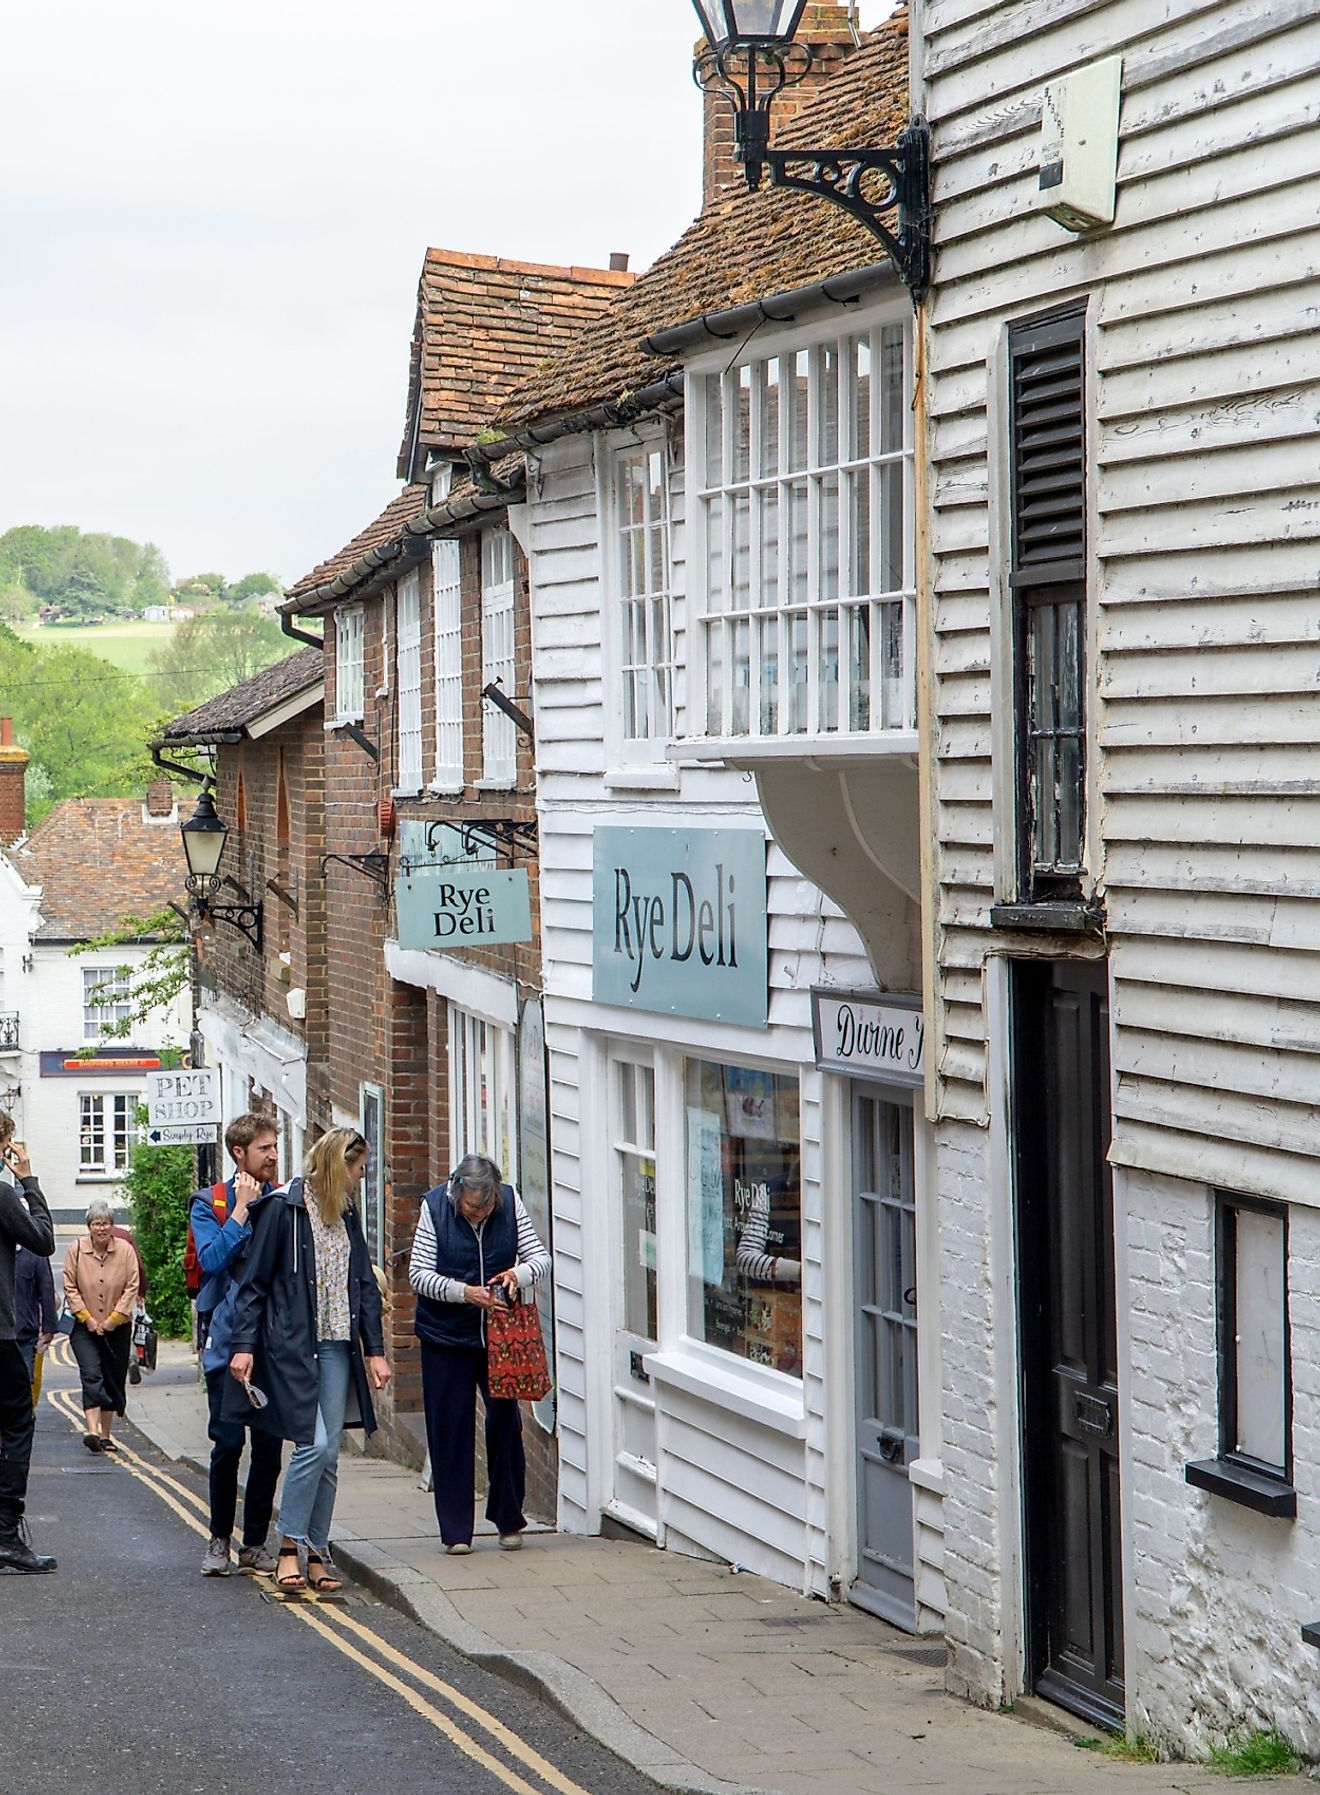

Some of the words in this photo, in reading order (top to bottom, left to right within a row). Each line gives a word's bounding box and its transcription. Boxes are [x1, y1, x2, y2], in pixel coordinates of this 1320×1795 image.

[438, 883, 491, 916] Rye
[433, 907, 496, 937] Deli
[615, 867, 665, 993] Rye
[671, 863, 738, 968] Deli
[836, 1004, 905, 1061] Divine
[155, 1074, 211, 1098] PET
[154, 1100, 214, 1119] SHOP
[162, 1128, 192, 1142] Simply
[196, 1127, 214, 1143] Rye
[734, 1178, 750, 1215] Rye
